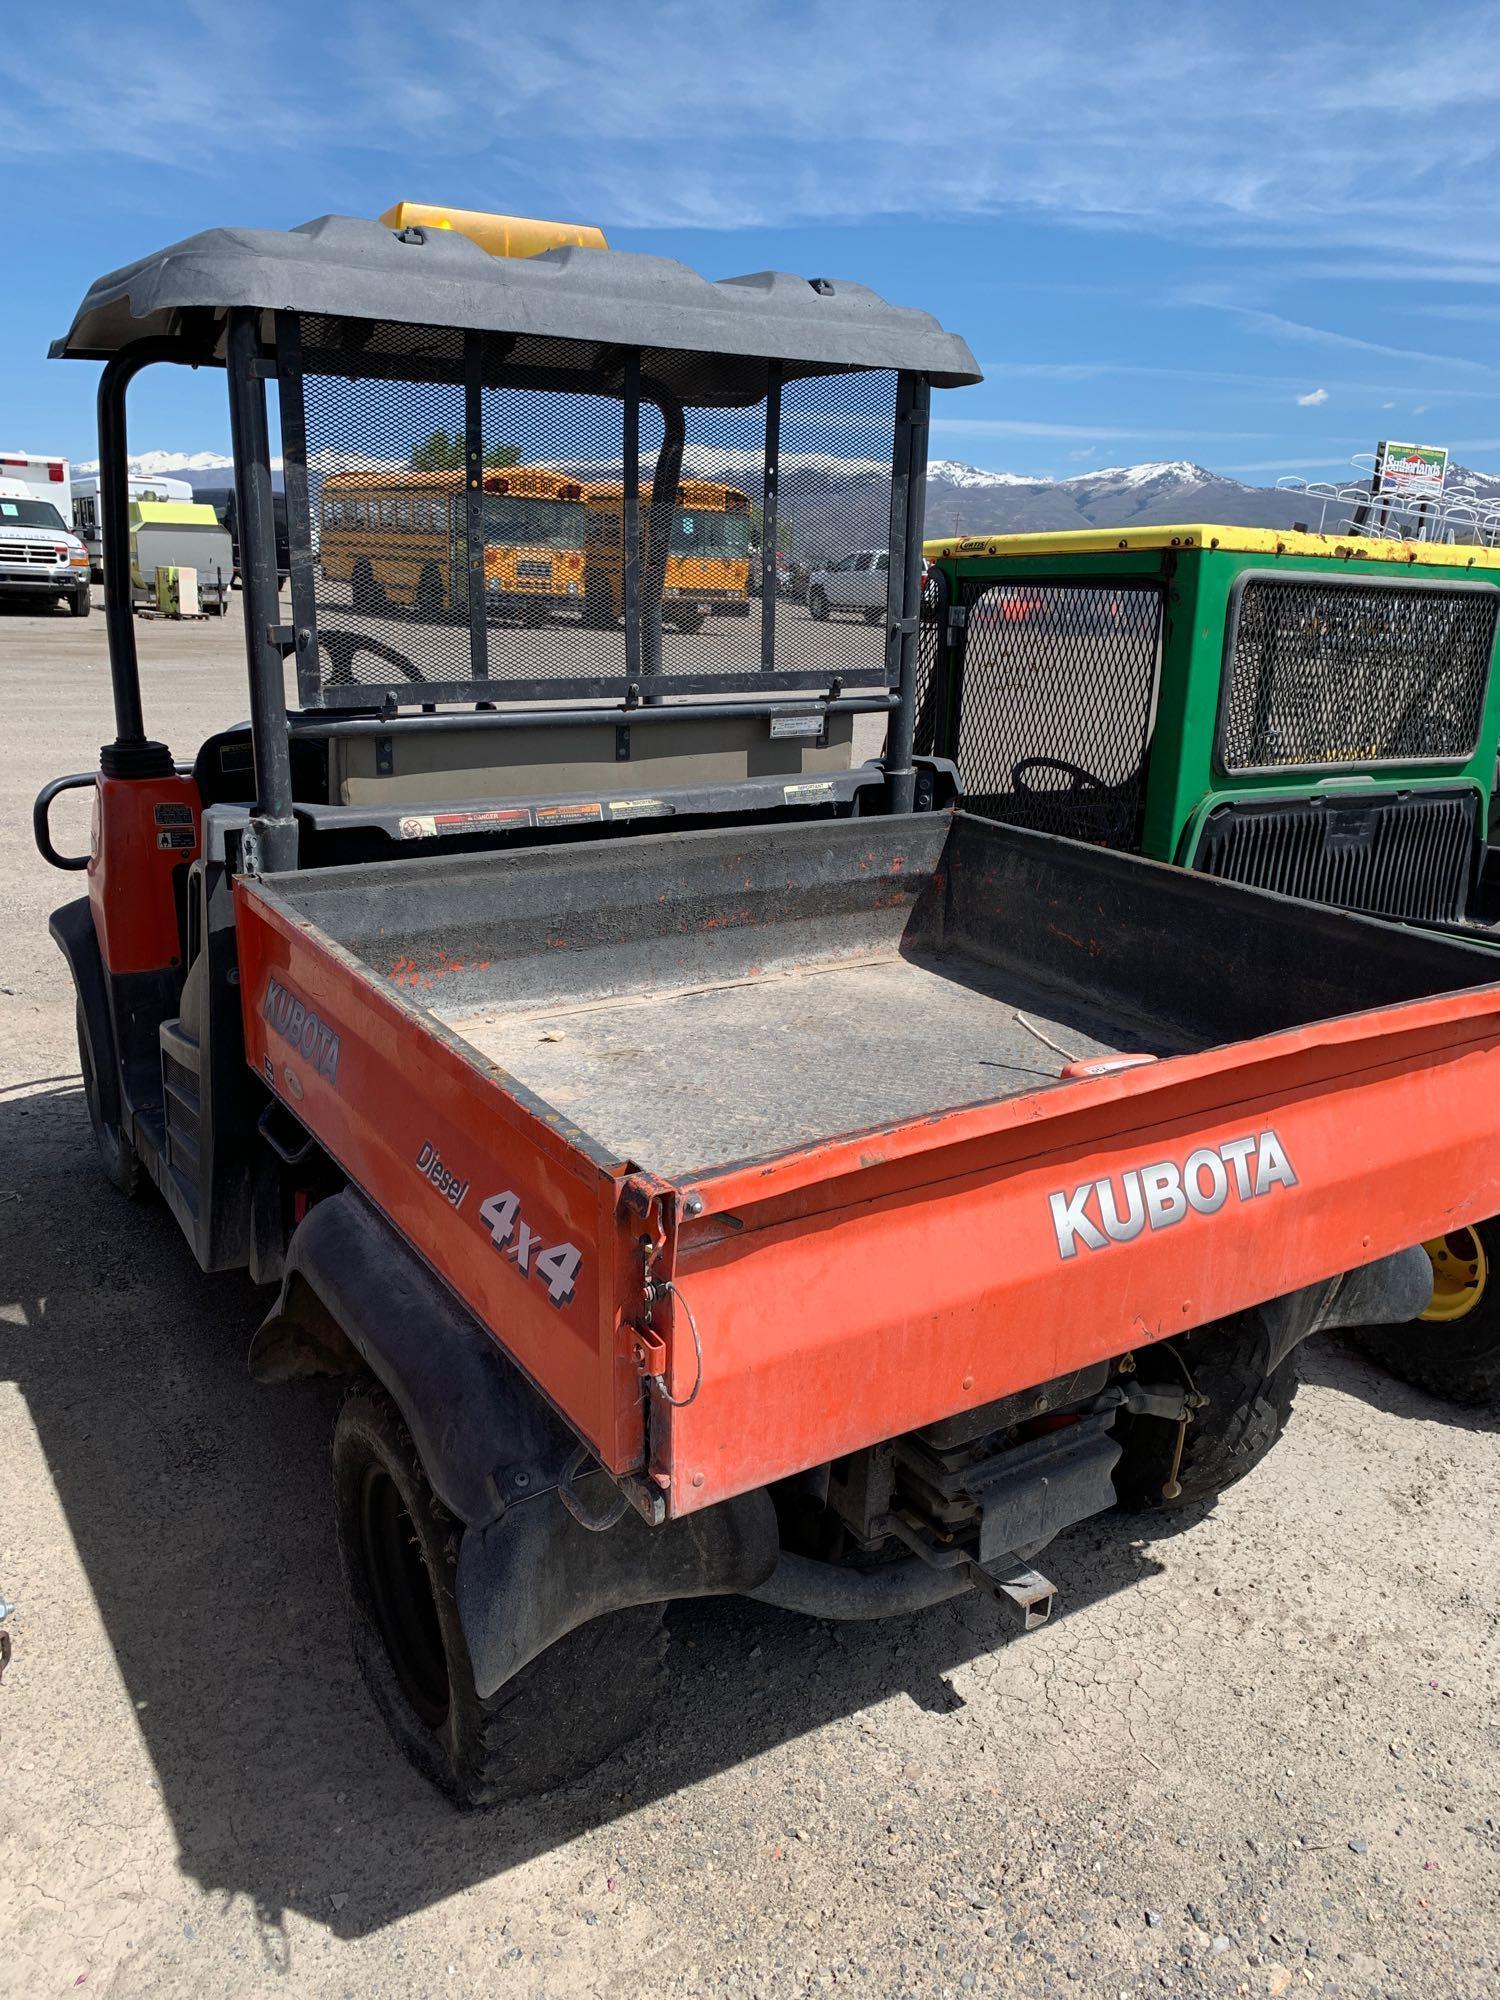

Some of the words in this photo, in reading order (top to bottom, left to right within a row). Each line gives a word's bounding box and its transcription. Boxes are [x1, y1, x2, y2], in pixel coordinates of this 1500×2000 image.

[1386, 454, 1441, 477] Sutherlands
[474, 813, 499, 821] DANGER
[262, 976, 341, 1086] KUBOTA
[415, 1138, 470, 1211] Diesel
[1048, 1129, 1299, 1260] KUBOTA
